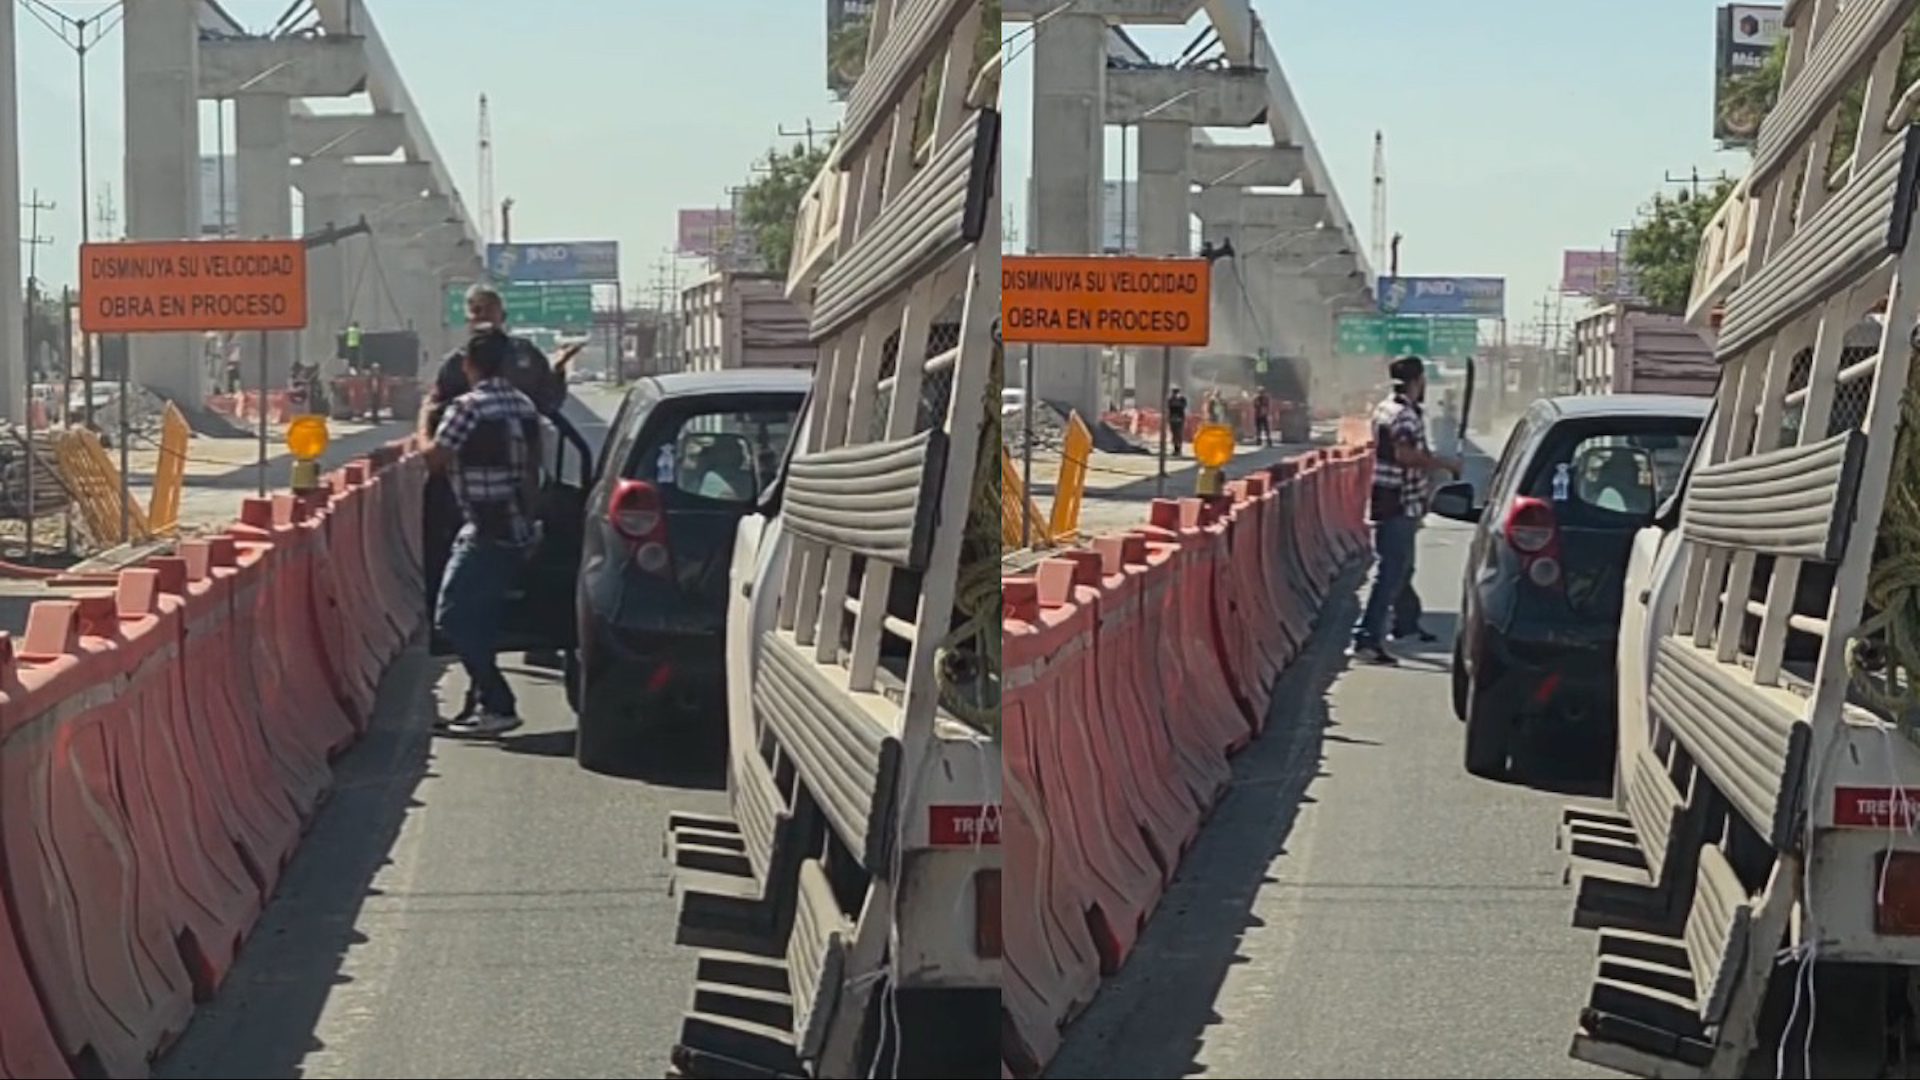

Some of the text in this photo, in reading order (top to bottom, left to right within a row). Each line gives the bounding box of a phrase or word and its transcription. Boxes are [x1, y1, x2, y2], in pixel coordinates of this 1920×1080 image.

[91, 254, 293, 279] DISMINUYA SU VELOCIDAD
[1002, 270, 1198, 294] DISMINUYA SU VELOCIDAD
[100, 293, 287, 318] OBRA EN PROCESO
[1007, 306, 1190, 332] OBRA EN PROCESO
